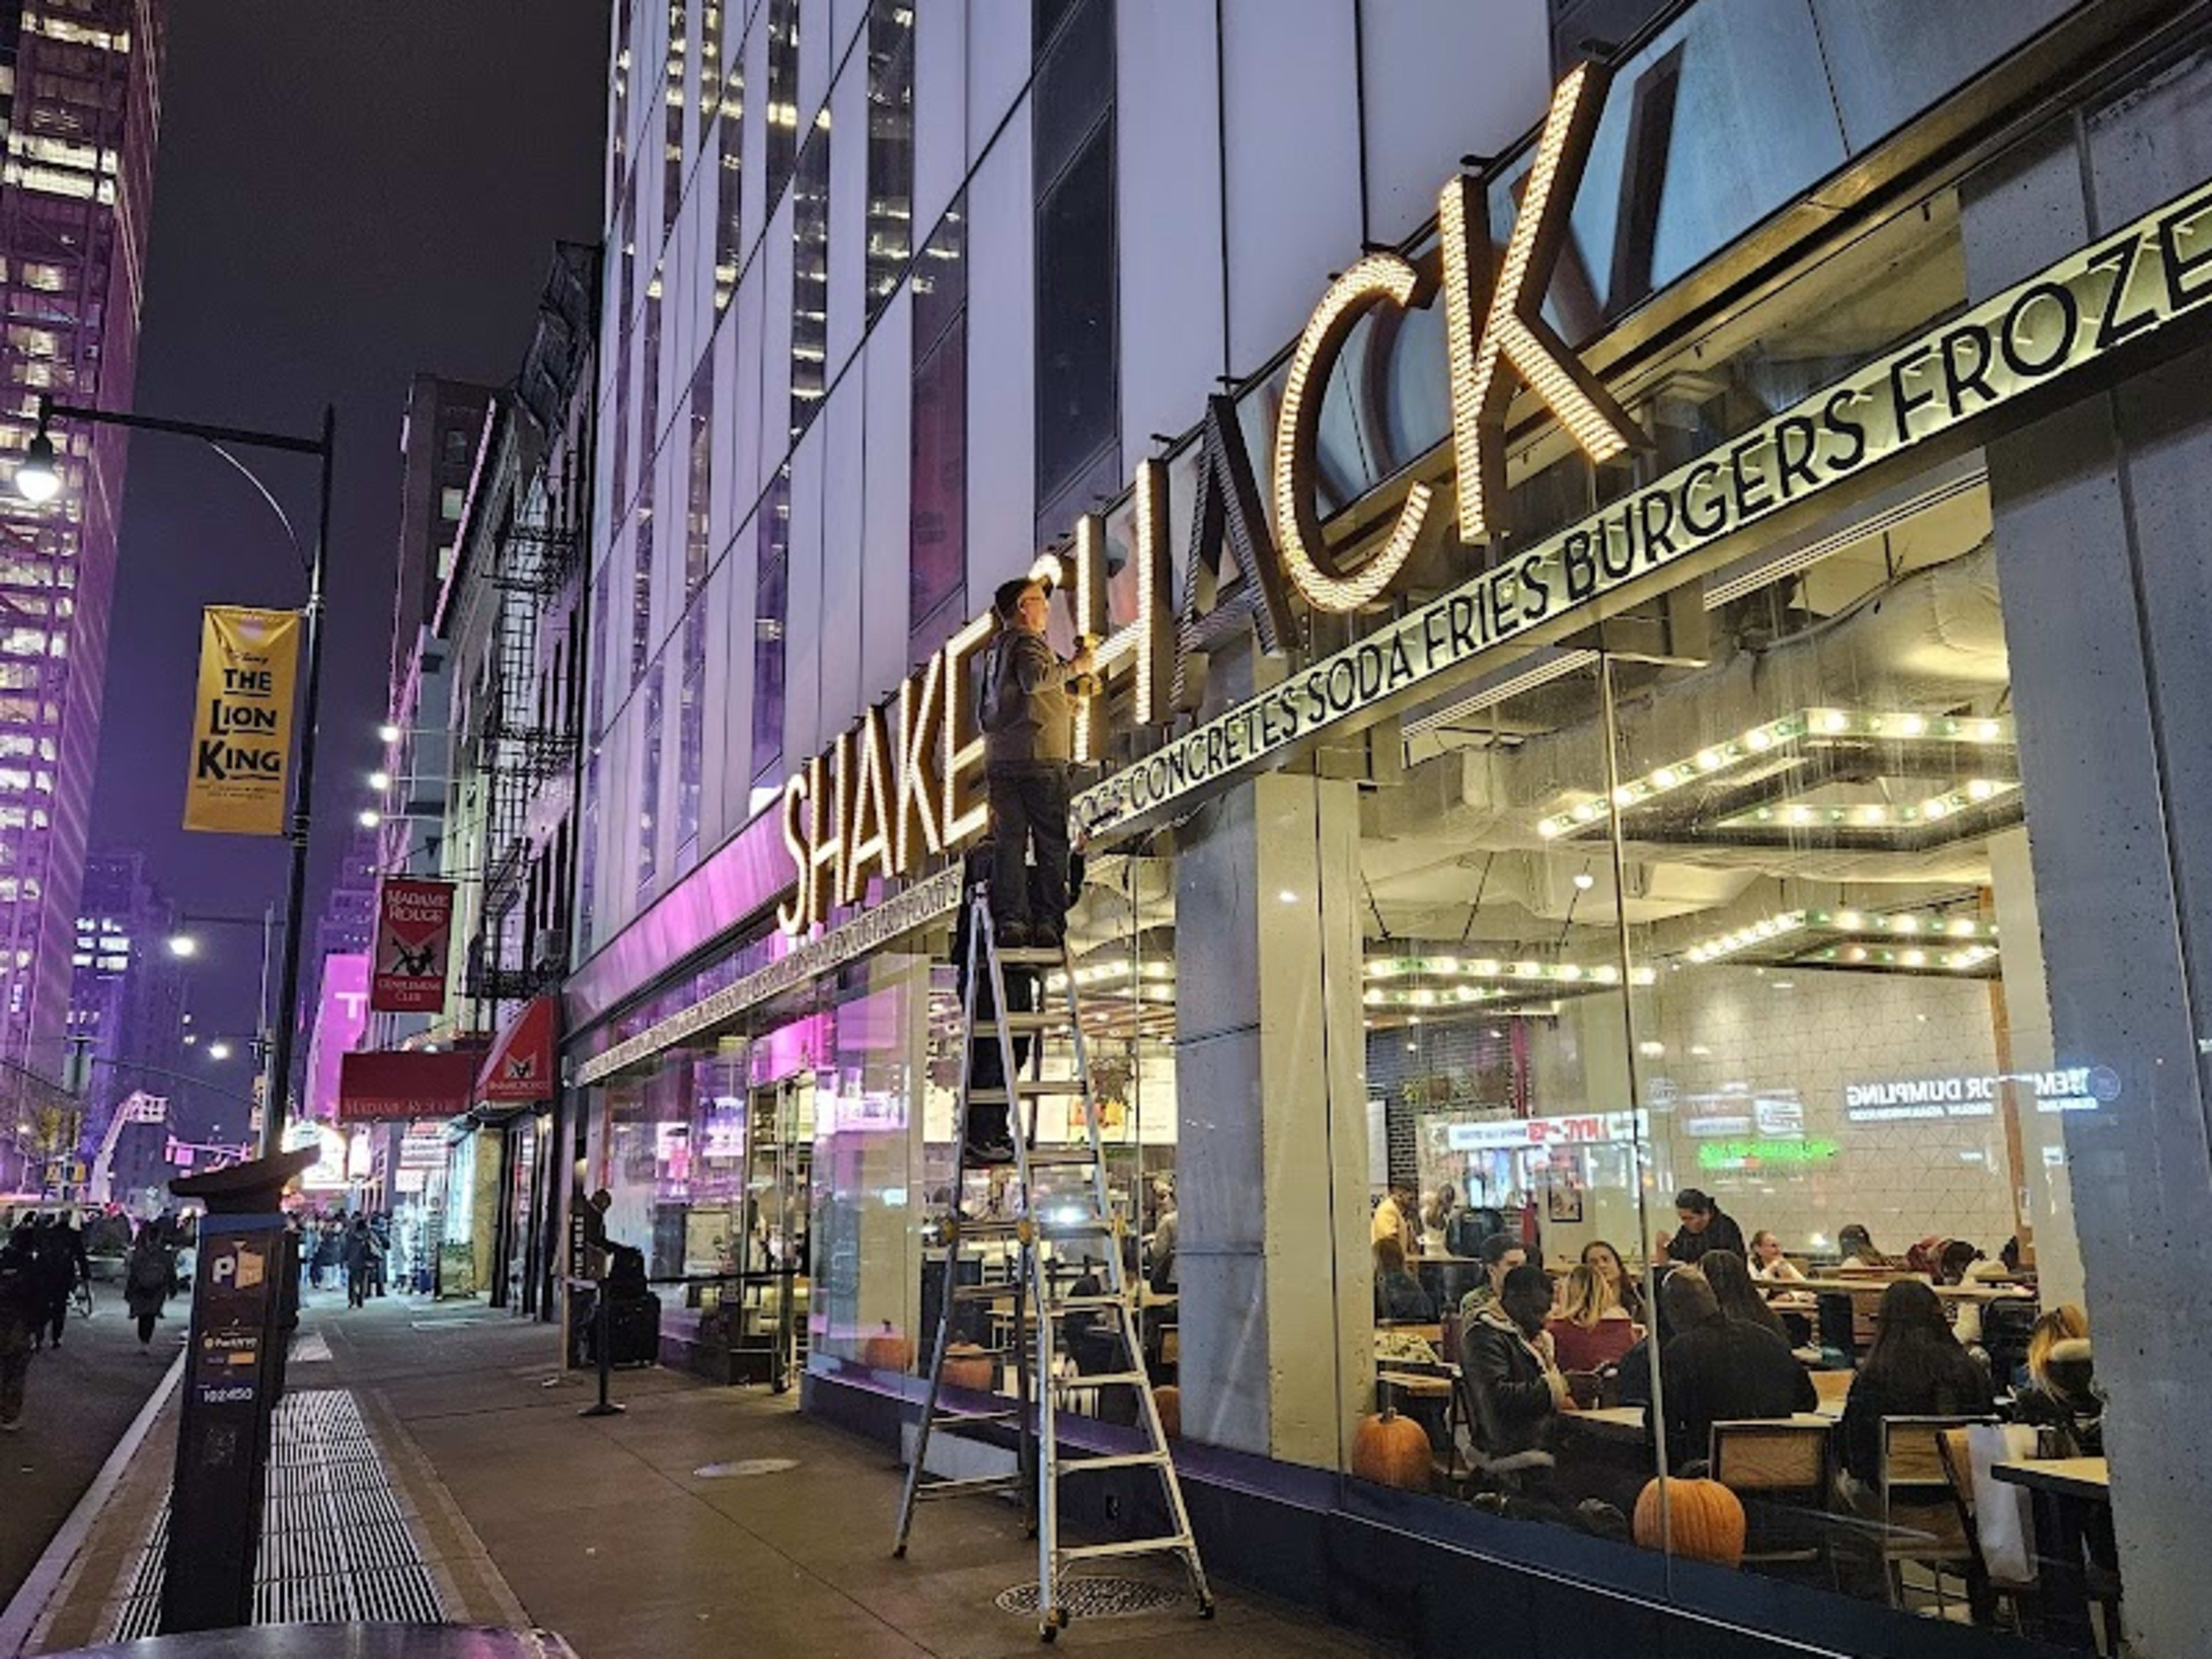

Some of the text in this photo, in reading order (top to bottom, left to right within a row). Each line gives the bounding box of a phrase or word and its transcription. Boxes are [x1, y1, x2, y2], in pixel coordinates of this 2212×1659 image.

[778, 58, 1649, 935] SHAKE HACK
[1129, 687, 1298, 809] CONCRETES
[1308, 628, 1415, 723] SODA
[1423, 555, 1549, 670] FRIES
[1563, 389, 1865, 600] BURGERS
[224, 669, 272, 692] THE
[389, 906, 444, 922] ROUGE
[213, 1255, 236, 1284] P
